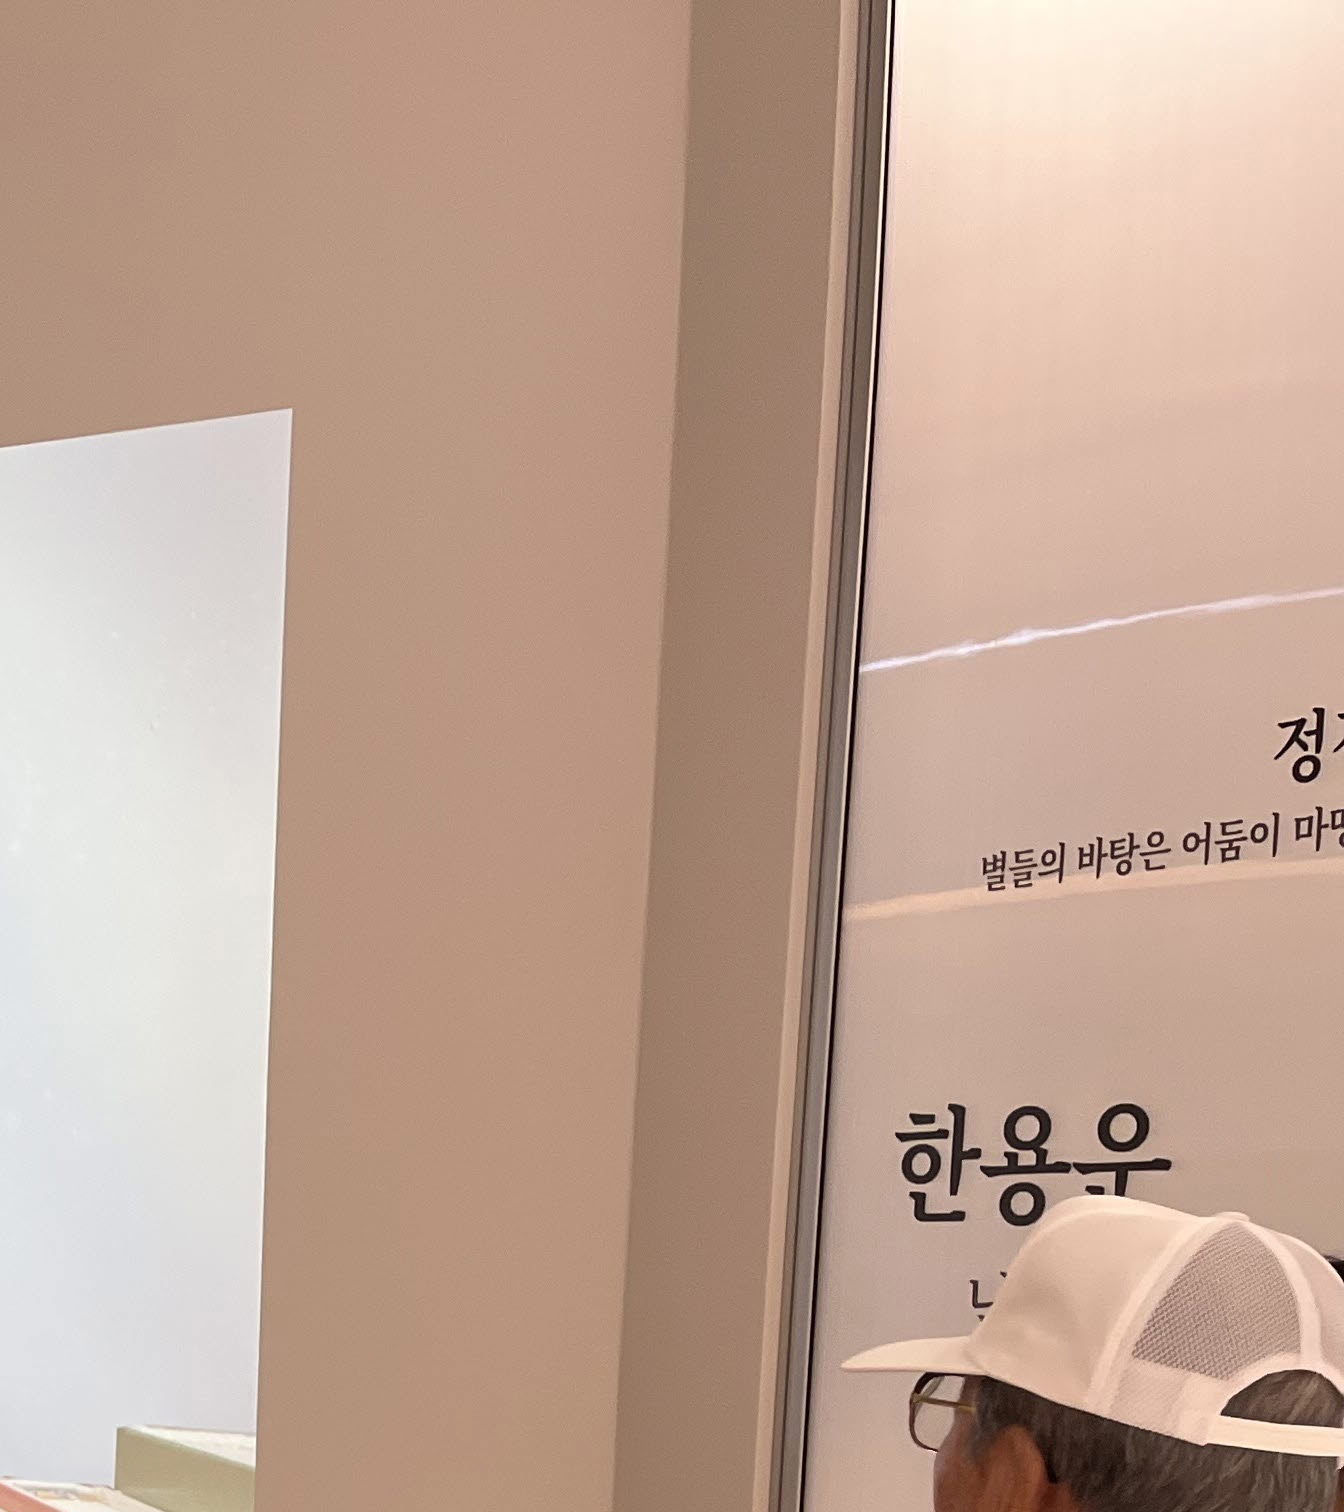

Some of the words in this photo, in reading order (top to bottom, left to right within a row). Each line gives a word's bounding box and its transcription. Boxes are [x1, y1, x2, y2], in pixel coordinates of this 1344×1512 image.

[1274, 707, 1344, 783] 정
[981, 842, 1066, 891] 별들의
[1077, 831, 1171, 876] 바탕은
[1182, 812, 1280, 866] 어둠이
[895, 1103, 1172, 1227] 한용운
